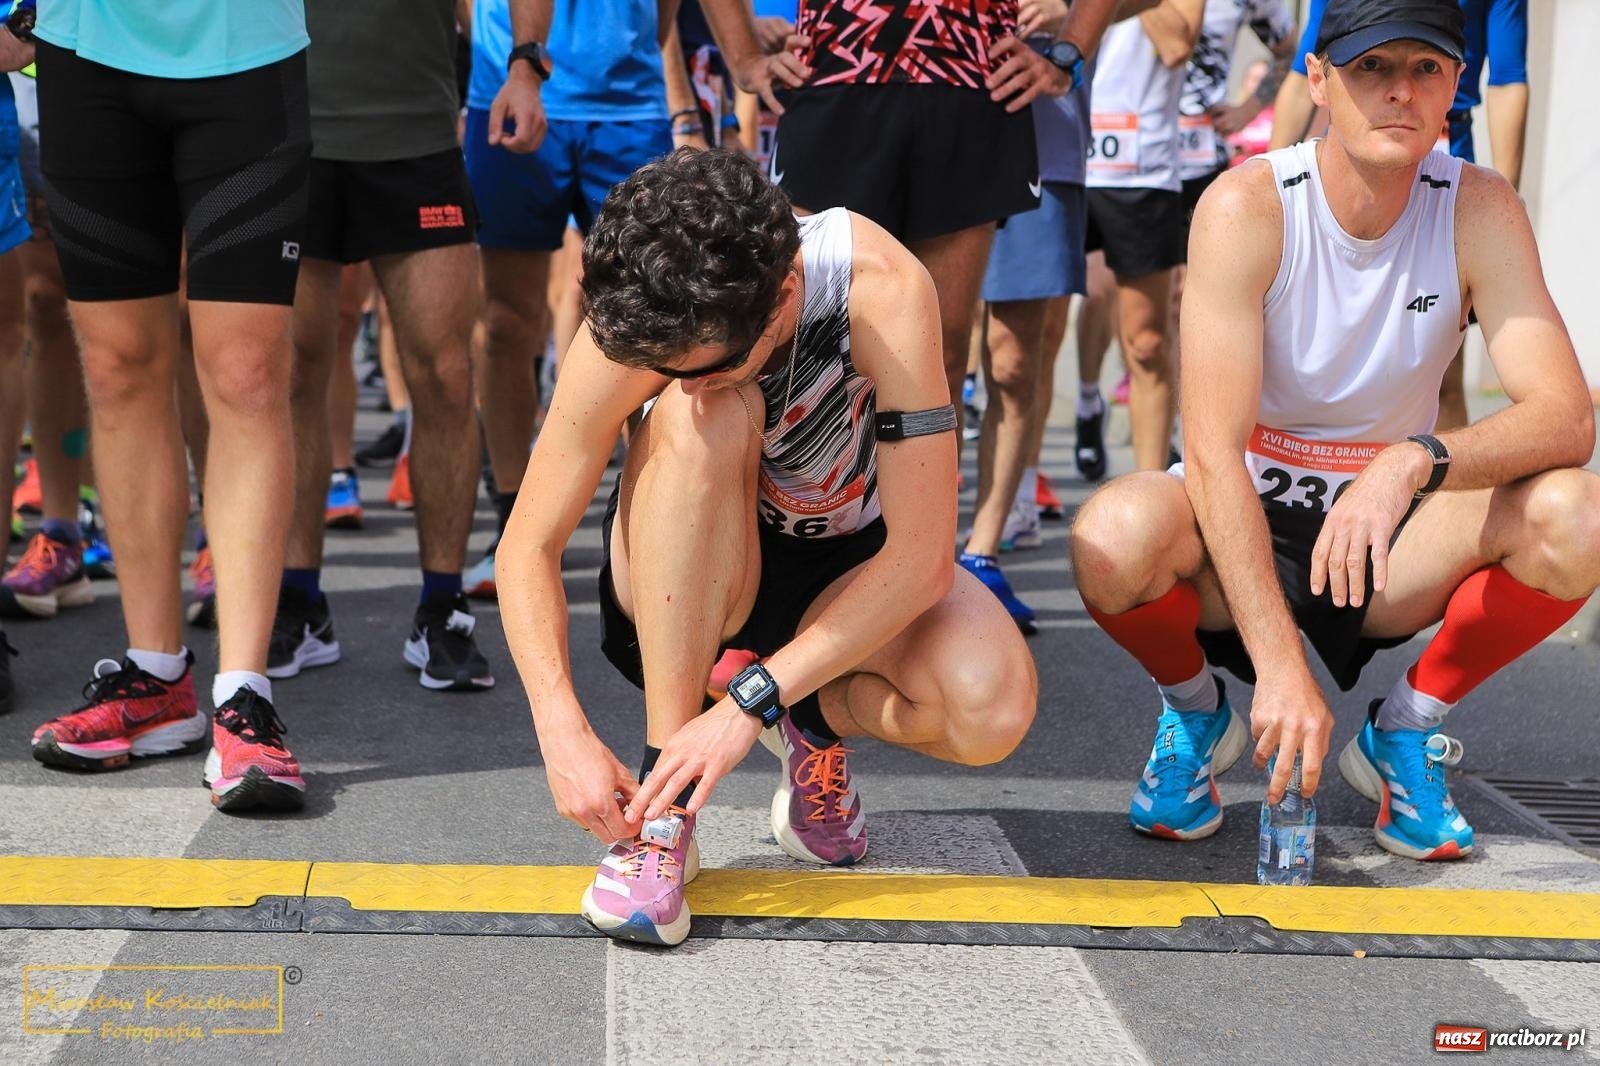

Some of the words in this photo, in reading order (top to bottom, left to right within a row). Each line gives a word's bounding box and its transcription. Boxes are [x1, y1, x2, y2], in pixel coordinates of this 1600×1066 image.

[1406, 294, 1439, 313] 4F
[1262, 430, 1282, 445] XVI
[1283, 438, 1310, 453] BIEG
[1312, 445, 1333, 456] BEZ
[1335, 446, 1376, 458] GRANIC
[776, 490, 798, 506] BEZ
[800, 490, 848, 509] GRANIC
